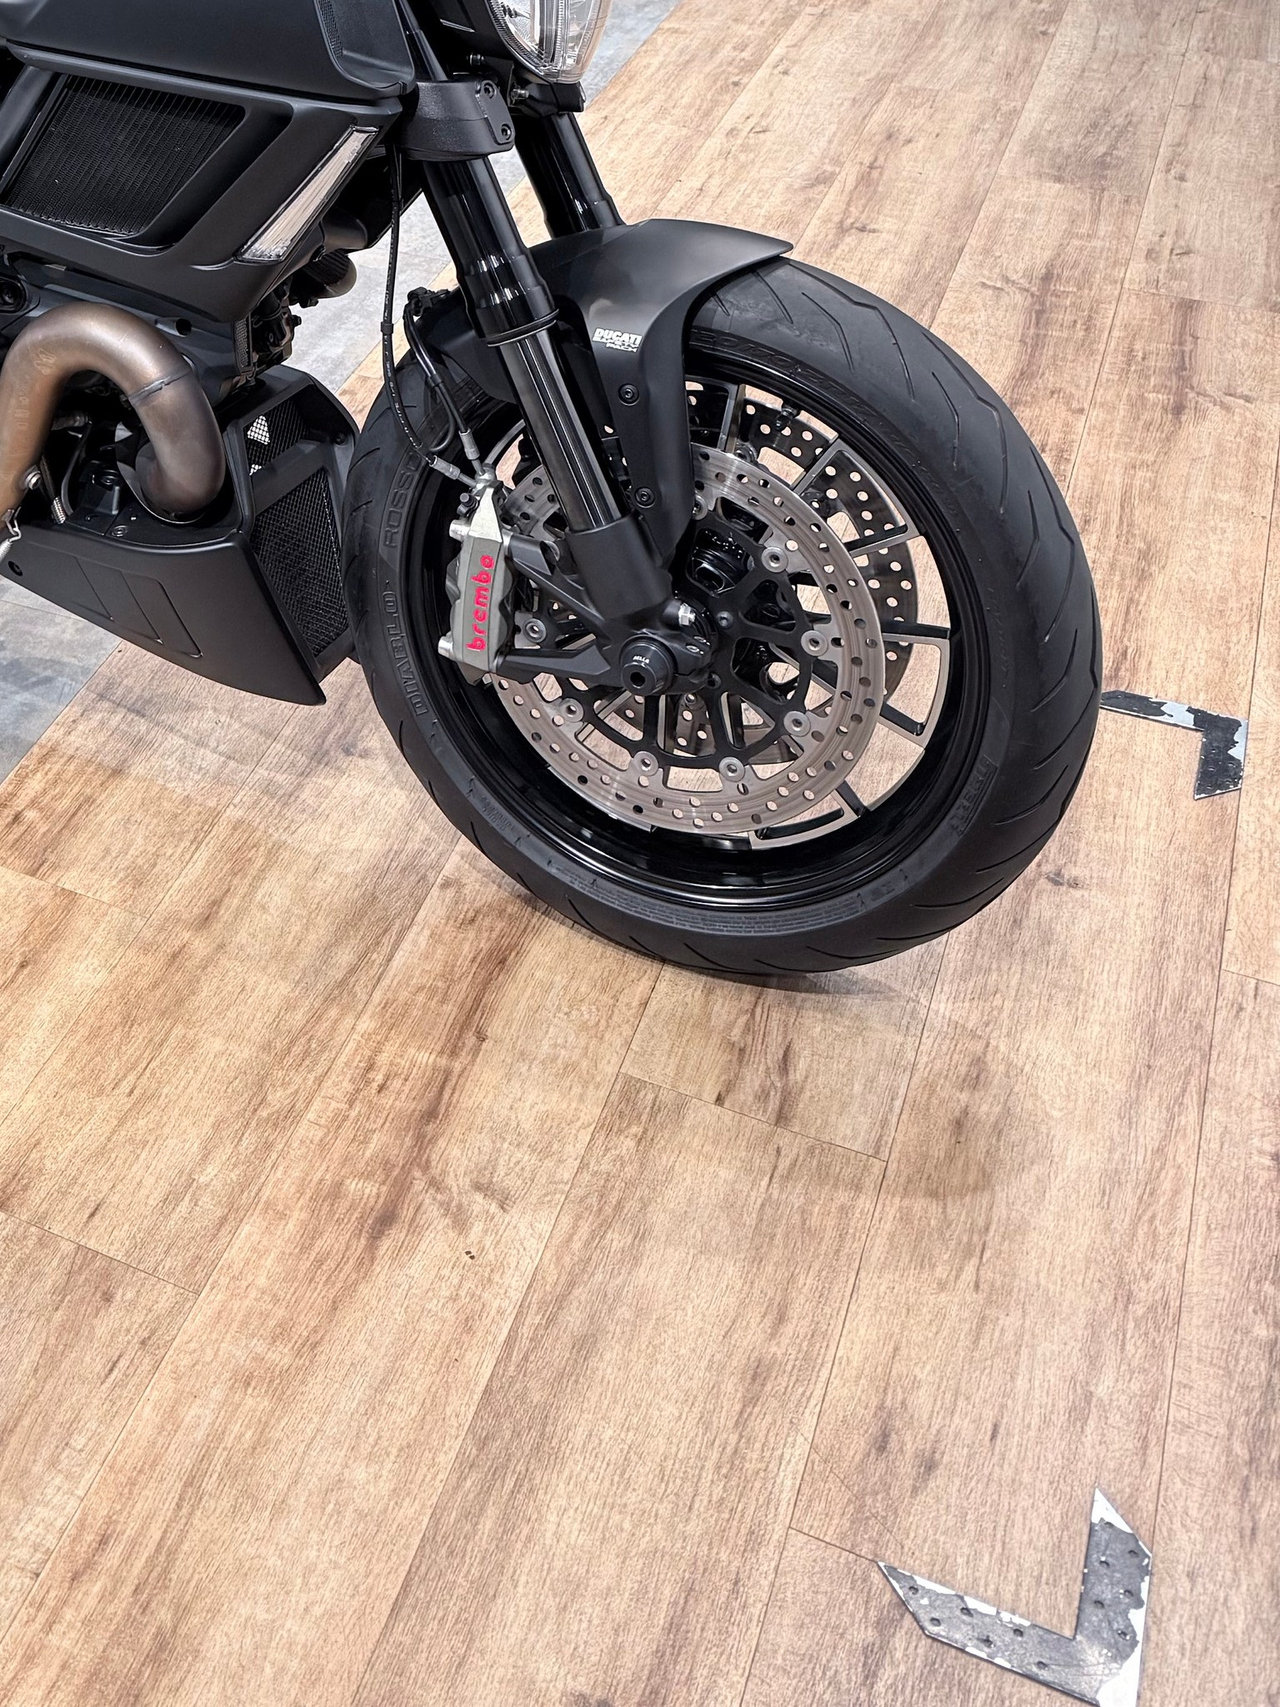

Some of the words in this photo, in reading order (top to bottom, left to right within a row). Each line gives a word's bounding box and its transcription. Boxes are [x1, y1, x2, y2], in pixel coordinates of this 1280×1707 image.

[593, 328, 643, 345] DUCATI
[467, 555, 495, 652] brembo
[382, 590, 429, 716] DIABLO
